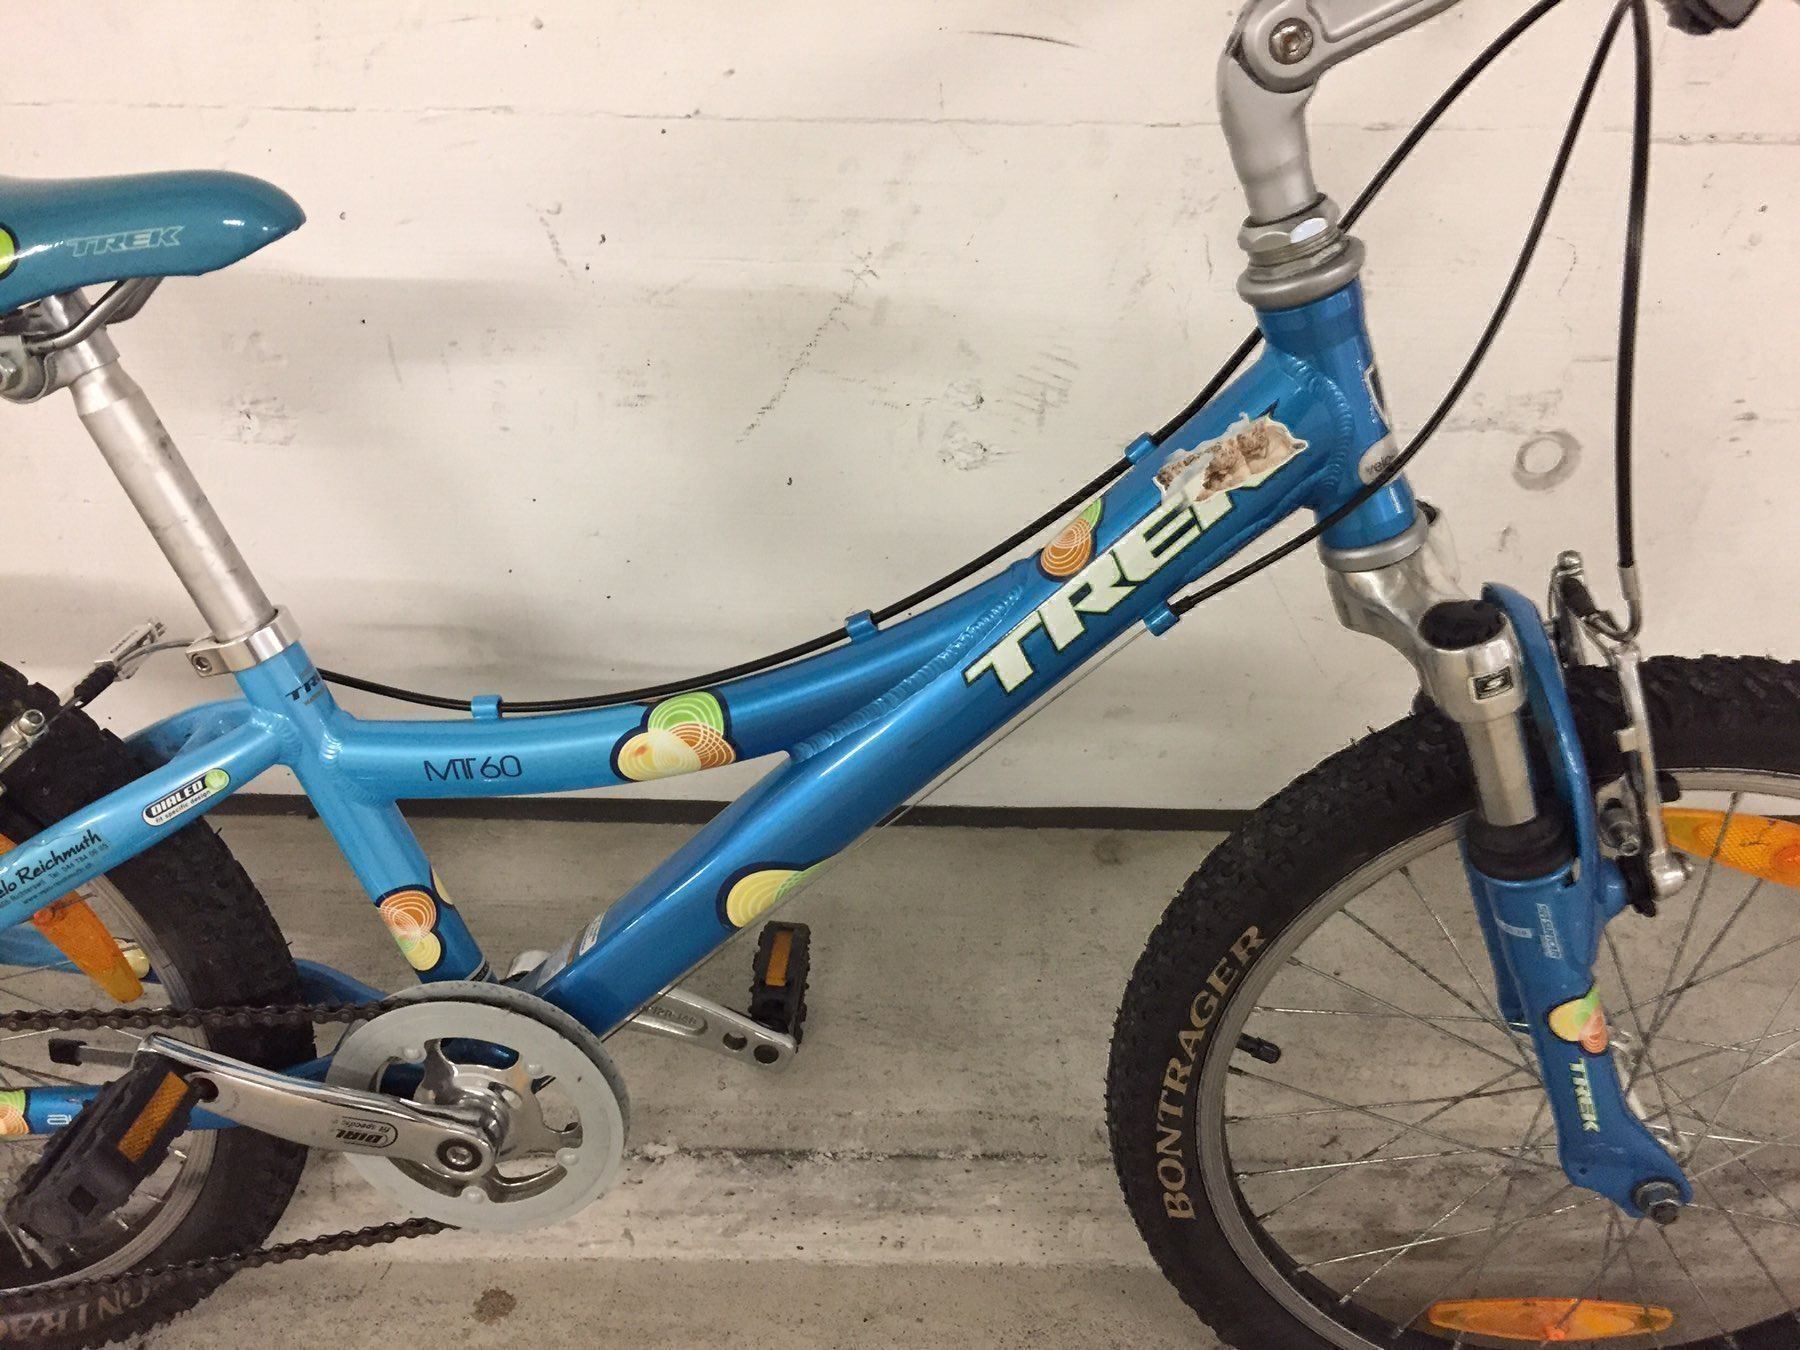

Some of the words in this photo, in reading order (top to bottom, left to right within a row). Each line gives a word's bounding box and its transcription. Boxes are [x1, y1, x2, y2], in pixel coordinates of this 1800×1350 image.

[67, 226, 186, 257] TREK
[165, 803, 189, 818] specific
[191, 790, 211, 805] design
[15, 829, 102, 884] Reichmuth
[1156, 925, 1265, 1220] BONTRAGER
[1569, 1057, 1600, 1133] TREK
